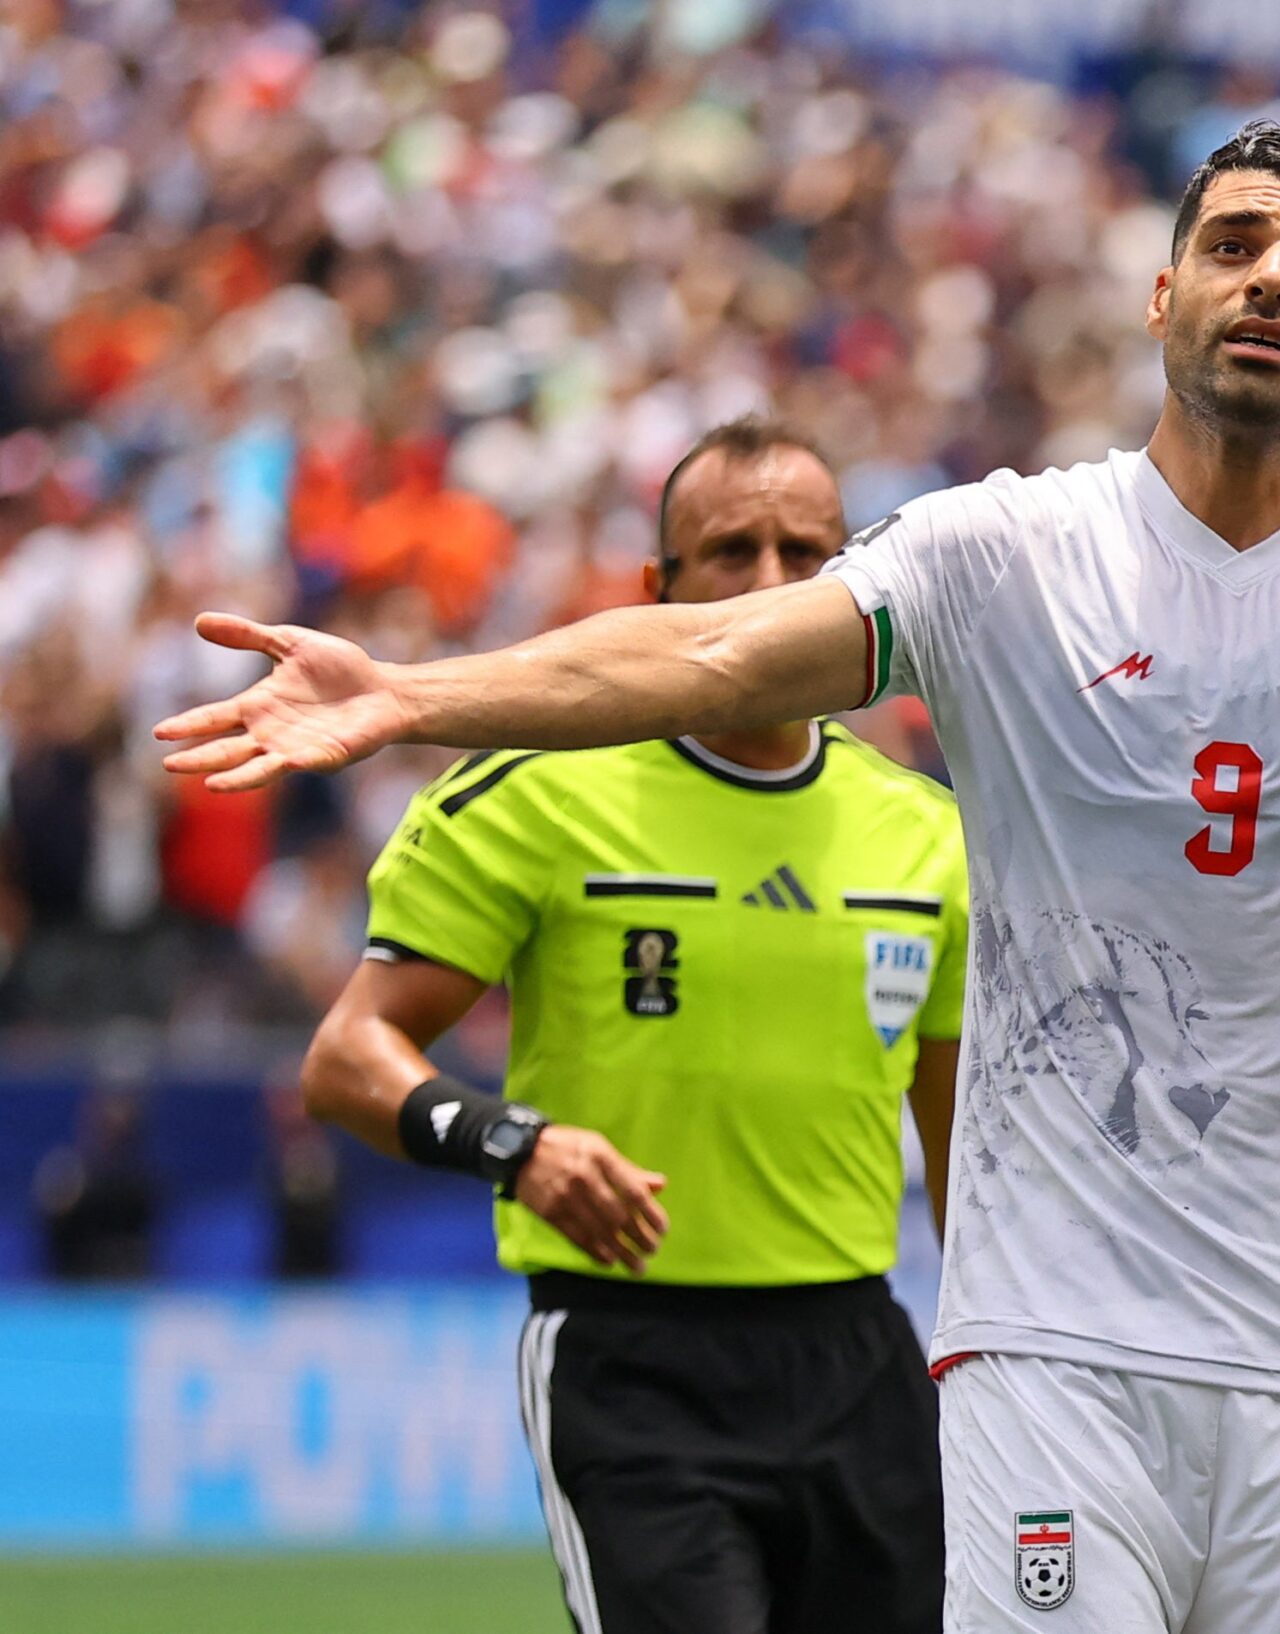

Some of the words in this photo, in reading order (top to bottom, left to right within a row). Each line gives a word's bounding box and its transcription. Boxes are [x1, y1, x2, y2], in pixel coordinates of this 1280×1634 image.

[1184, 740, 1264, 877] 9
[876, 942, 928, 971] FIFA
[132, 1292, 527, 1540] POW
